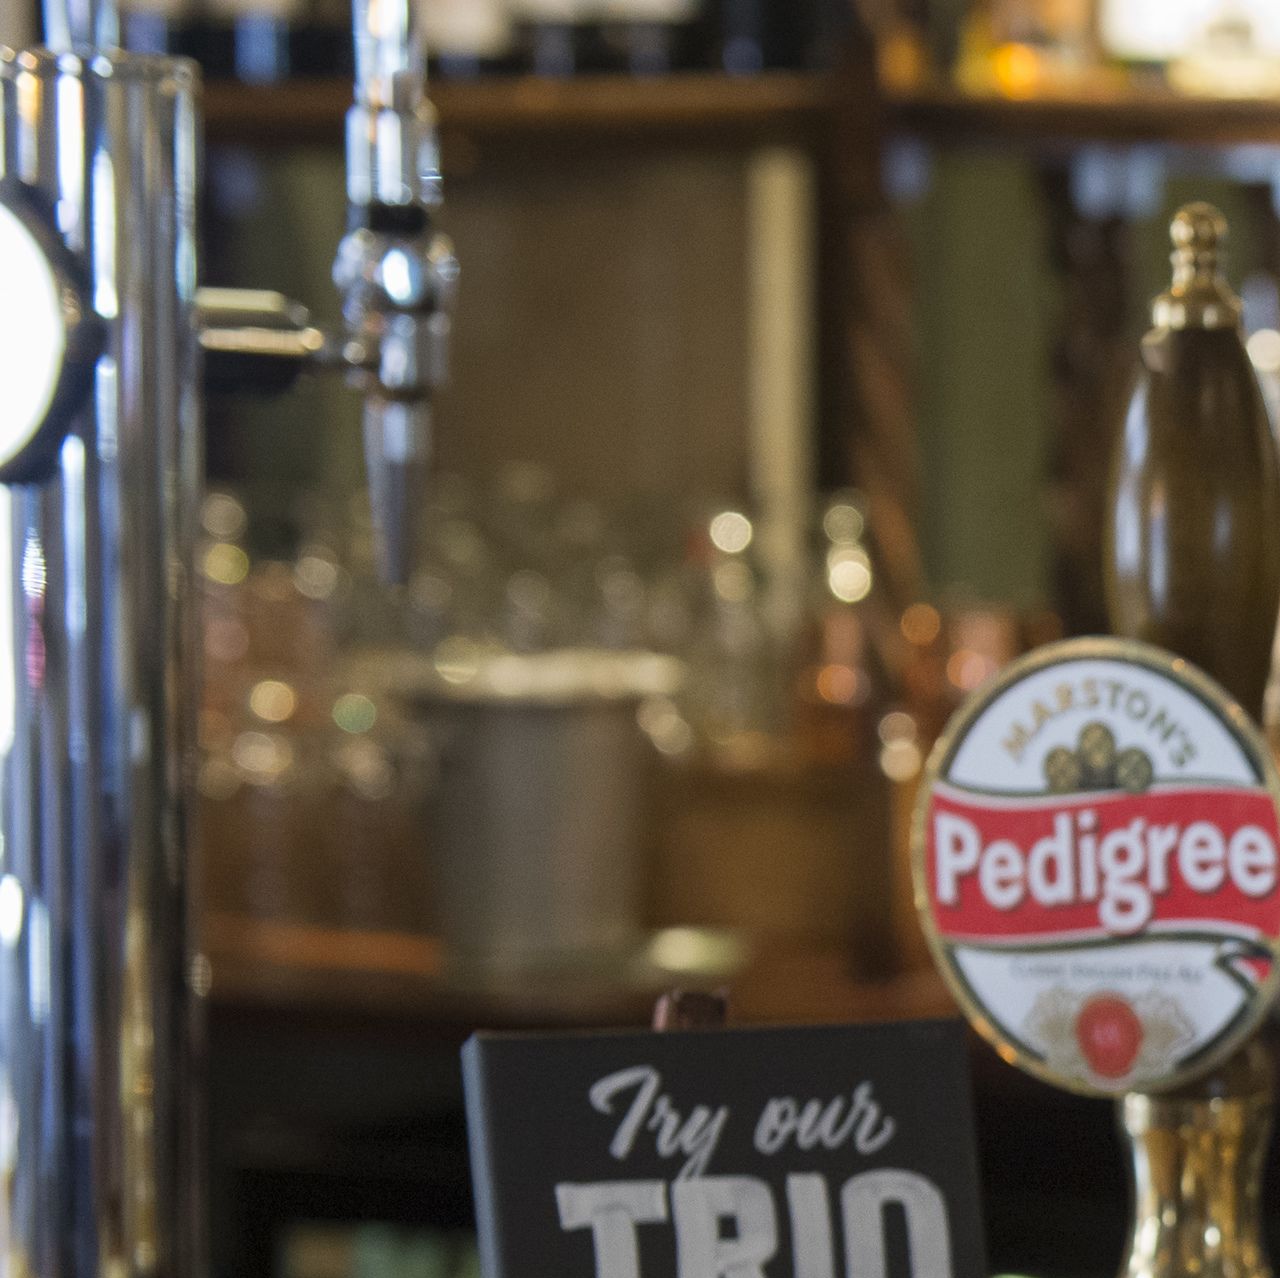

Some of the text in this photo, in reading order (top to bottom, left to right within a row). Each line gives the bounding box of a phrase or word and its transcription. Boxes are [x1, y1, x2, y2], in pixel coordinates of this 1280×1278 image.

[1003, 677, 1197, 767] MARSTON'S
[934, 811, 1277, 935] Pedigree
[589, 1065, 895, 1180] Try our
